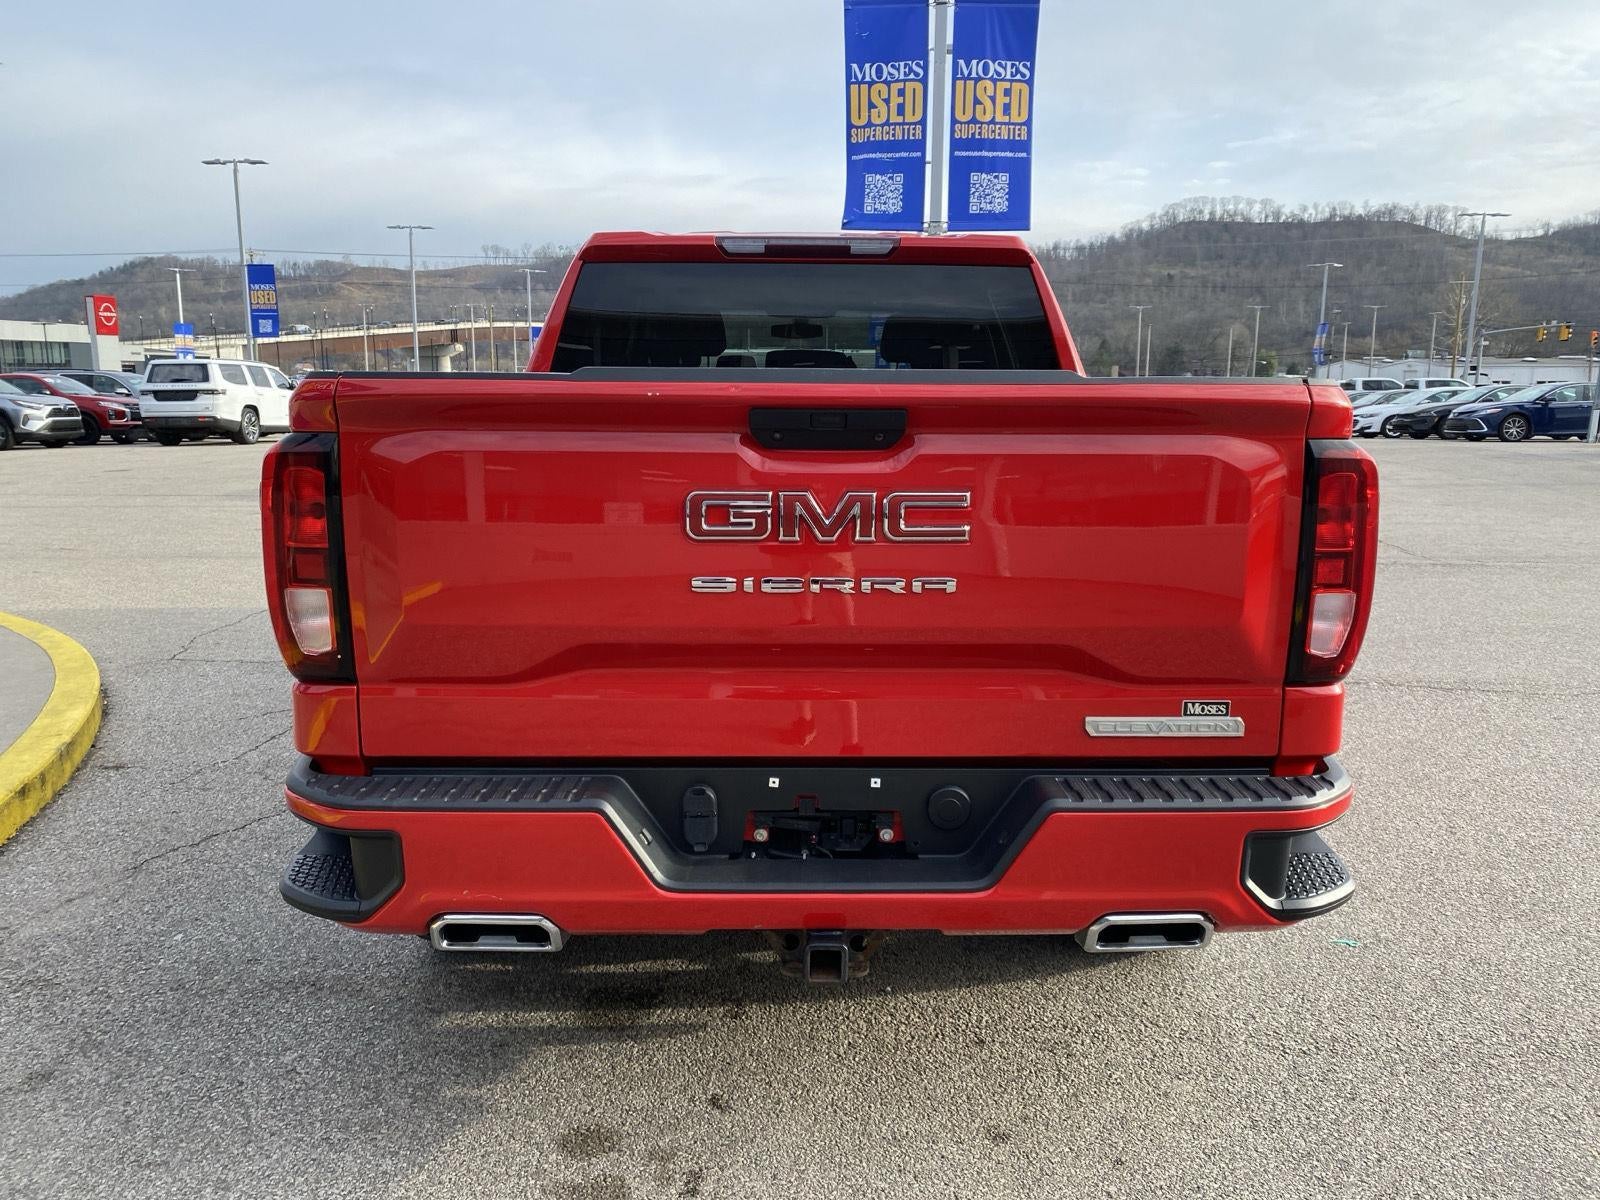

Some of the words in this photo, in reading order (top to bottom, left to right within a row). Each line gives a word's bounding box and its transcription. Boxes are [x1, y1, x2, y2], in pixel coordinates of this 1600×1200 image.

[850, 60, 924, 82] MOSES
[957, 59, 1030, 80] MOSES
[851, 81, 924, 126] USED
[955, 80, 1029, 123] USED
[851, 125, 922, 143] SUPERCENTER
[954, 123, 1027, 140] SUPERCENTER
[851, 151, 922, 160] mosesusedsupercenter.com
[954, 150, 1027, 158] mosesusedsupercenter.com
[251, 290, 276, 304] USED
[685, 490, 971, 543] GMC
[691, 576, 957, 594] SIERRA
[1186, 702, 1227, 715] MOSES
[1096, 719, 1234, 734] ELEVATION
